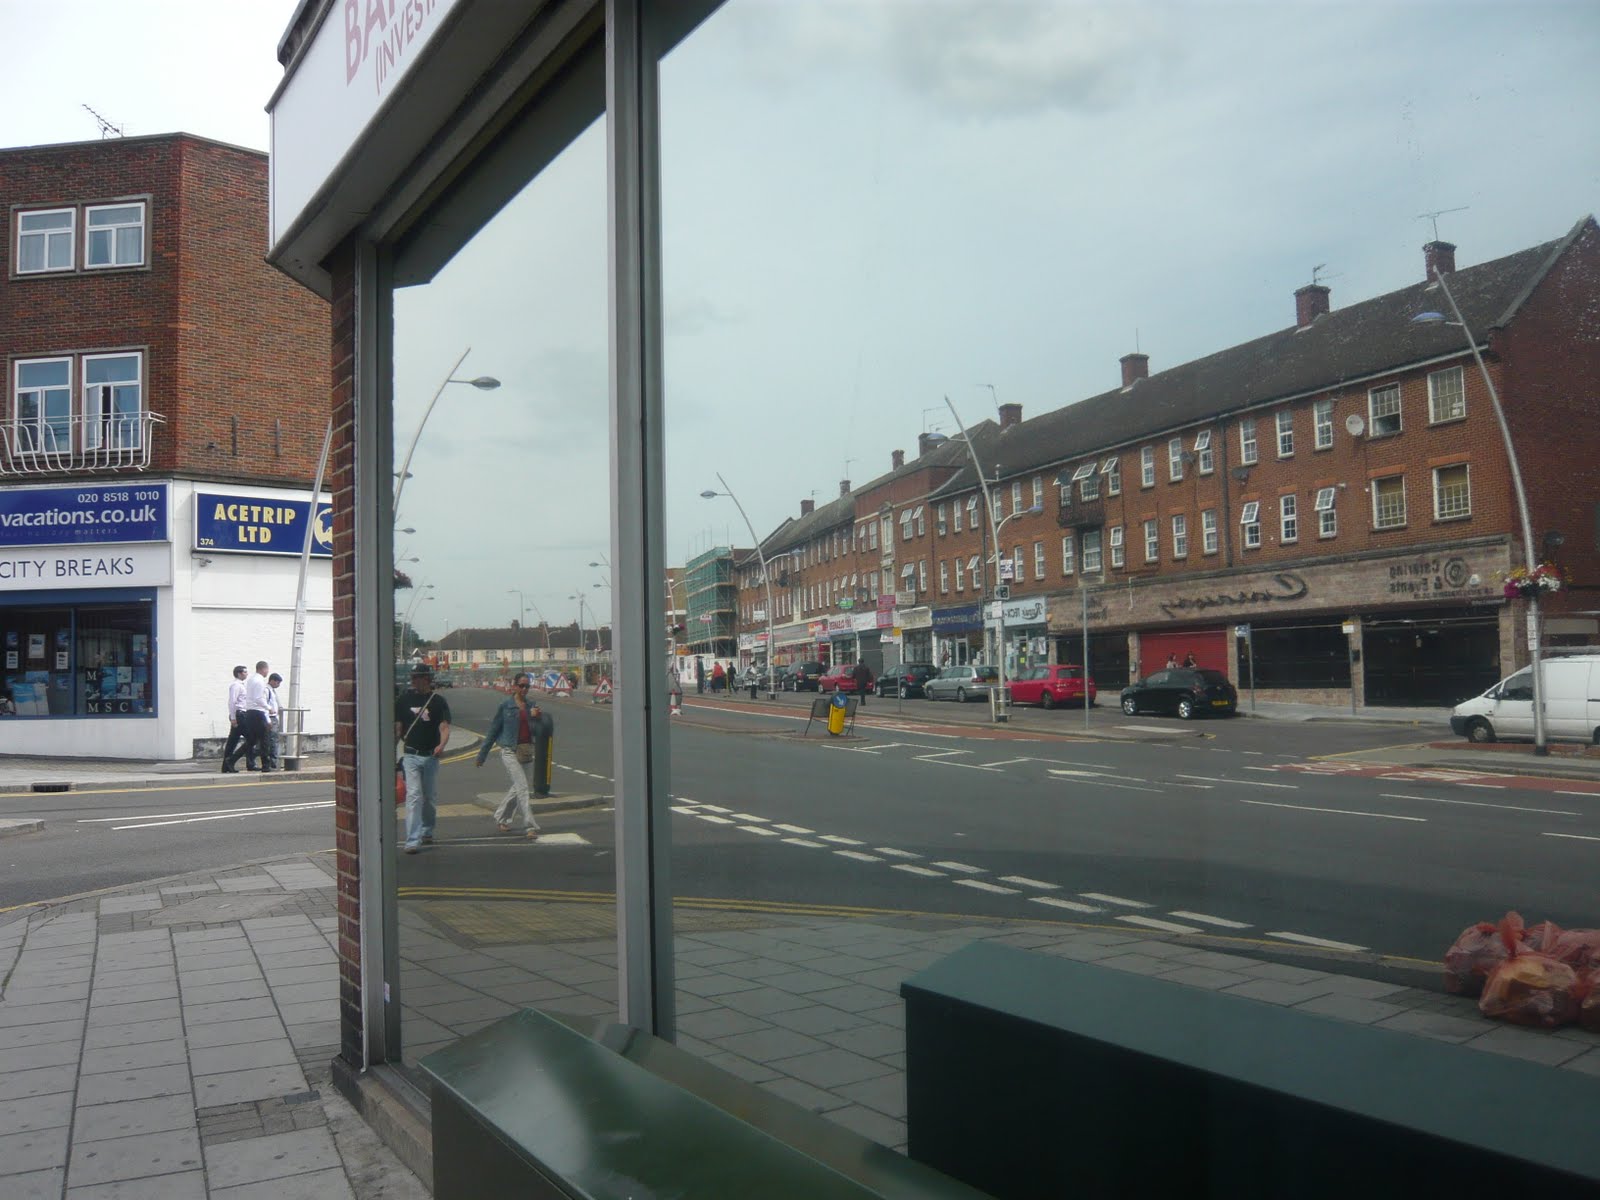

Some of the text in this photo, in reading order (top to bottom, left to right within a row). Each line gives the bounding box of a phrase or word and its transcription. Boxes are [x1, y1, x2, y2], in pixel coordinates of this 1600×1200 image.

[344, 0, 396, 87] BA
[77, 490, 160, 503] 020 8518 1010
[1, 504, 157, 527] vacations.co.uk
[213, 503, 296, 525] ACETRIP
[200, 537, 214, 546] 374
[238, 525, 272, 544] LTD
[0, 557, 134, 579] CITY BREAKS
